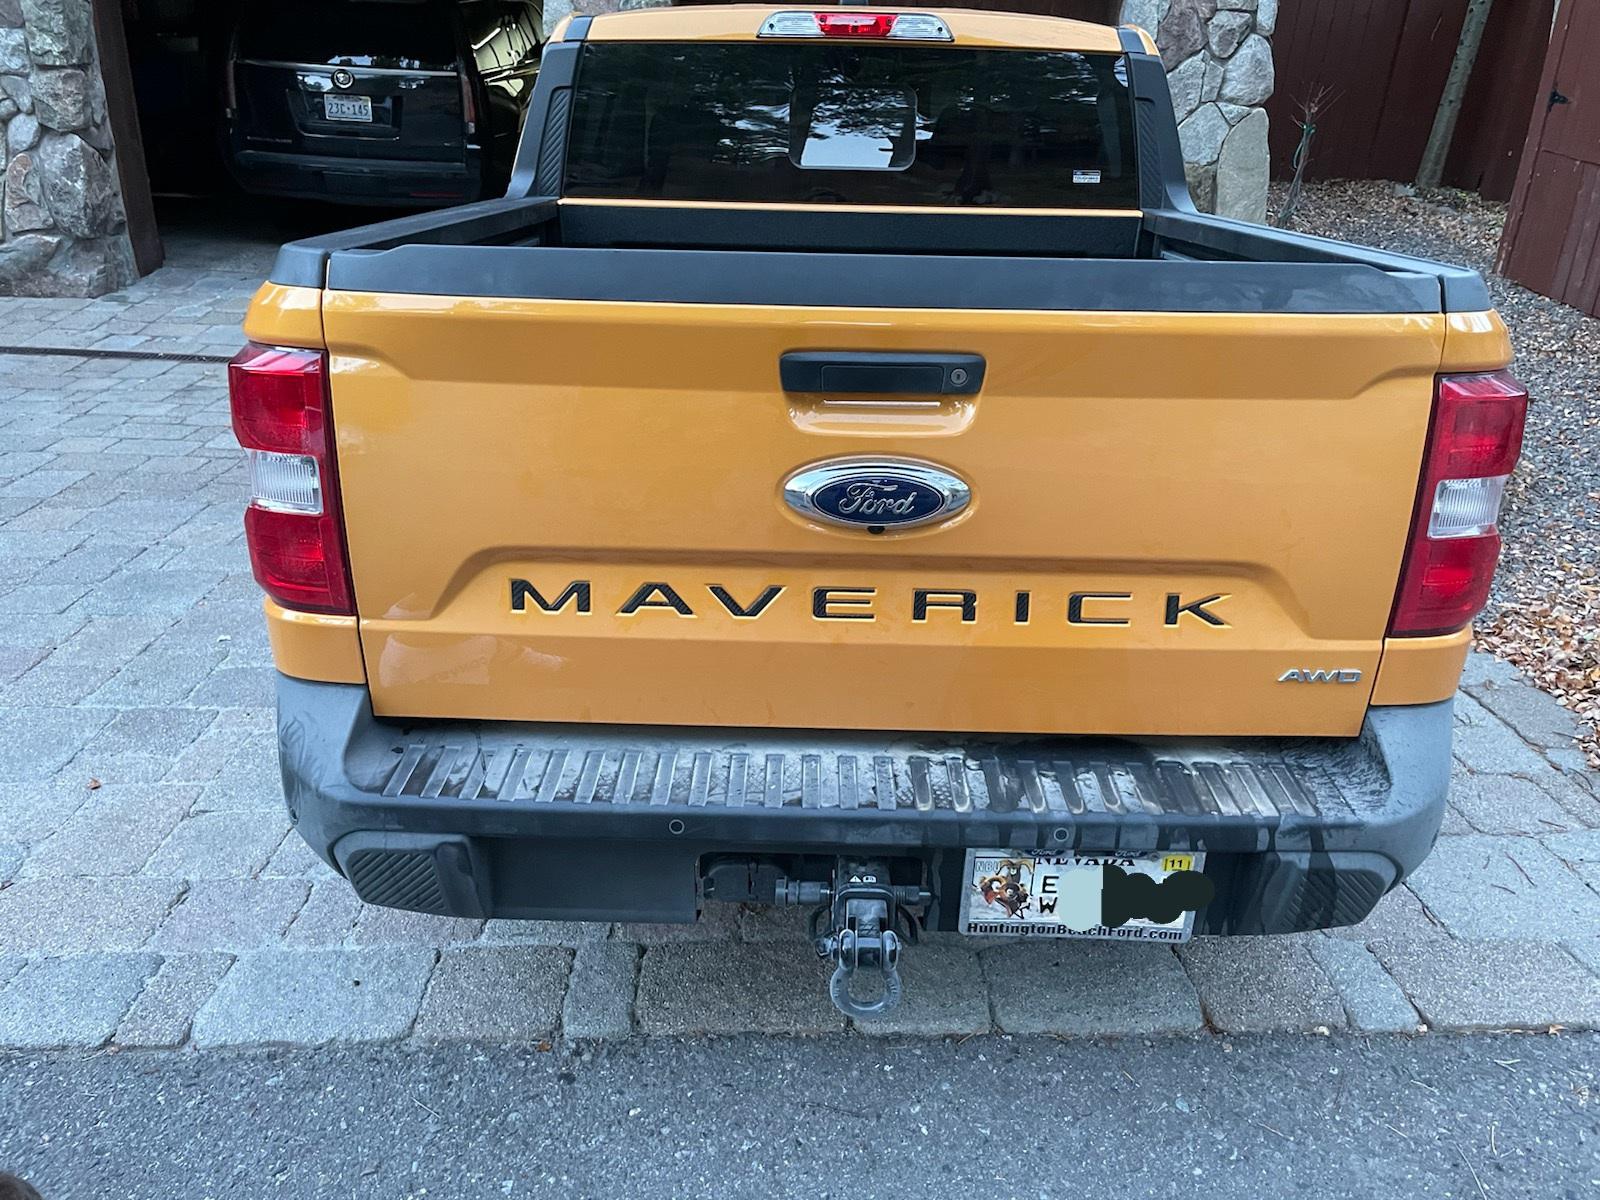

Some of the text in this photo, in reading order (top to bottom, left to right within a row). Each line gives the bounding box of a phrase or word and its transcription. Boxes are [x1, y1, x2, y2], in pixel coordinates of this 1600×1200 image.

[839, 481, 918, 515] Ford
[510, 578, 1232, 628] MAVERICK
[1277, 668, 1362, 683] AWD
[1030, 848, 1057, 857] Ford
[1169, 859, 1183, 868] 11
